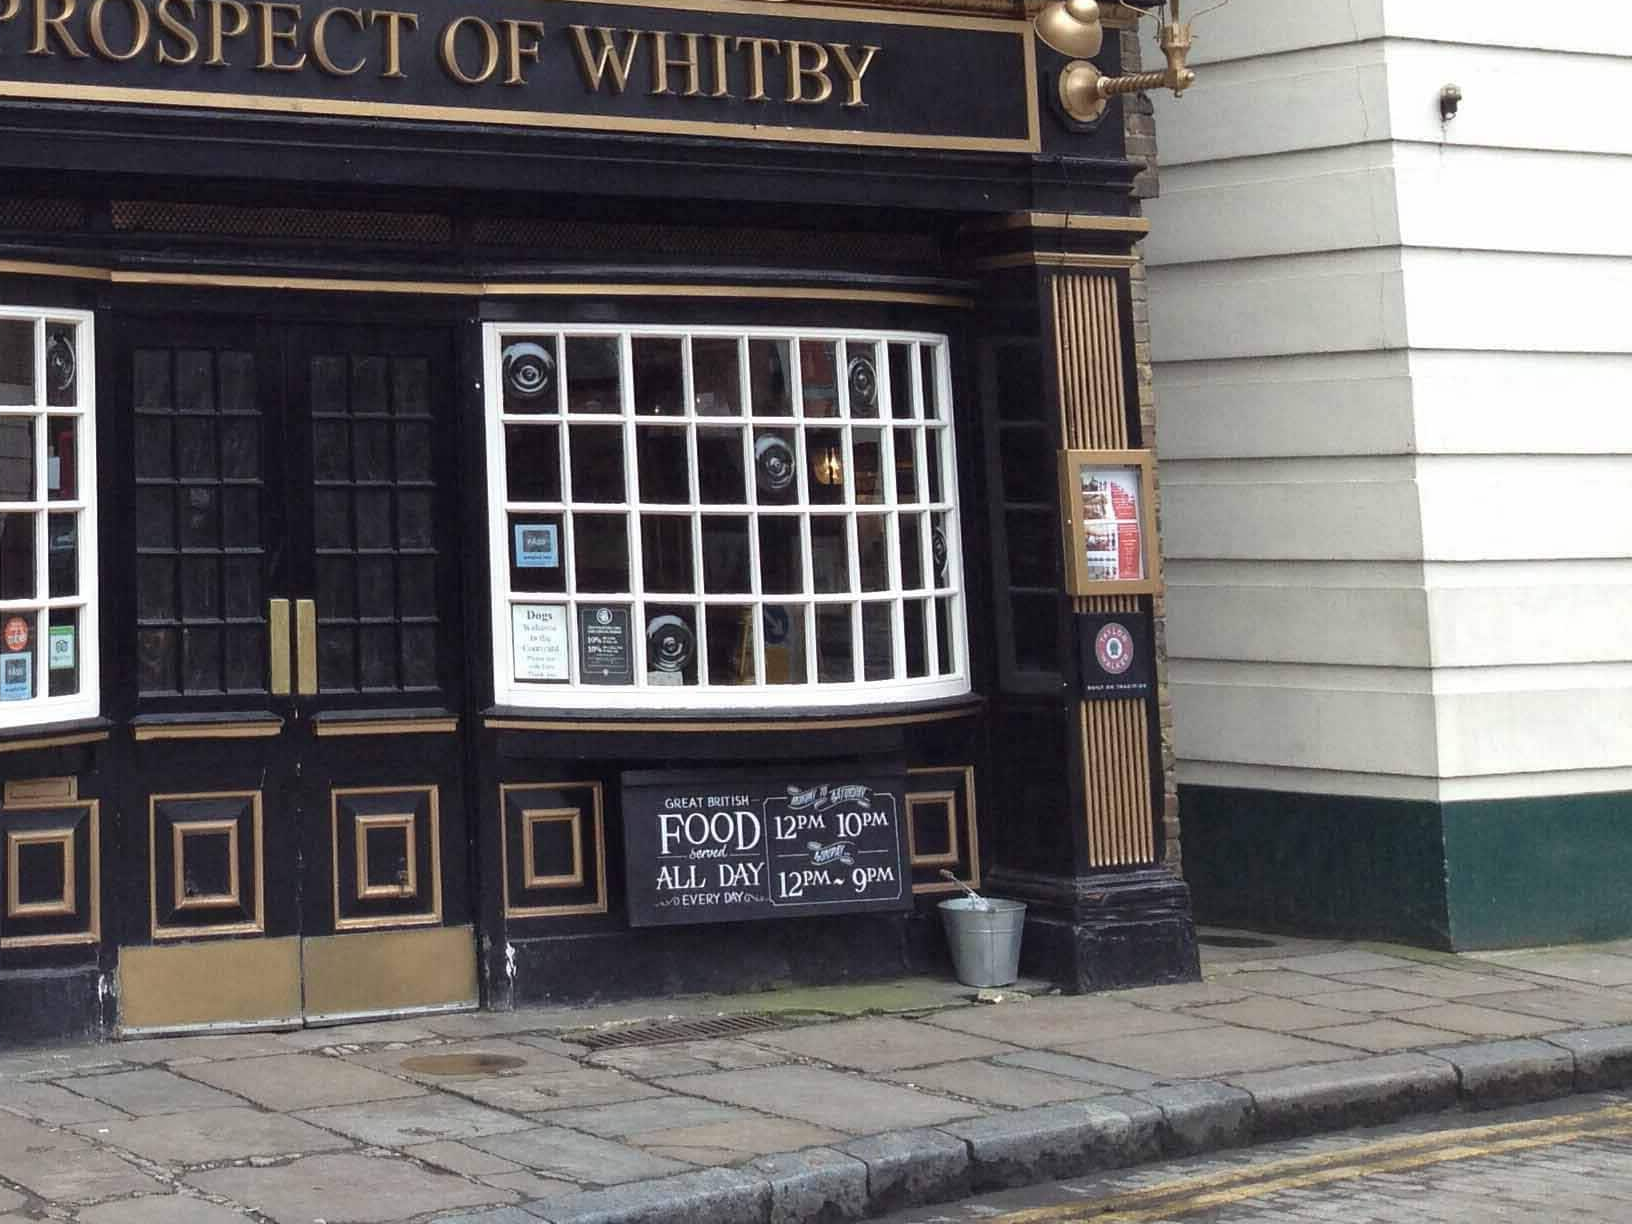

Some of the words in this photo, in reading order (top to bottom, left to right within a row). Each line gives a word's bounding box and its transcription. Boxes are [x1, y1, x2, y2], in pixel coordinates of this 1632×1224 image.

[440, 16, 545, 85] OF
[568, 24, 882, 108] WHITBY
[527, 610, 553, 622] Dogs
[665, 796, 704, 809] GREAT
[707, 795, 750, 808] BRITISH
[658, 811, 761, 855] FOOD
[774, 815, 825, 840] 12PM
[836, 812, 889, 837] 10PM
[689, 844, 728, 860] served
[656, 865, 706, 890] ALL
[719, 862, 765, 887] DAY
[852, 867, 895, 893] 9PM
[682, 893, 720, 906] EVERY
[724, 892, 745, 904] DAY
